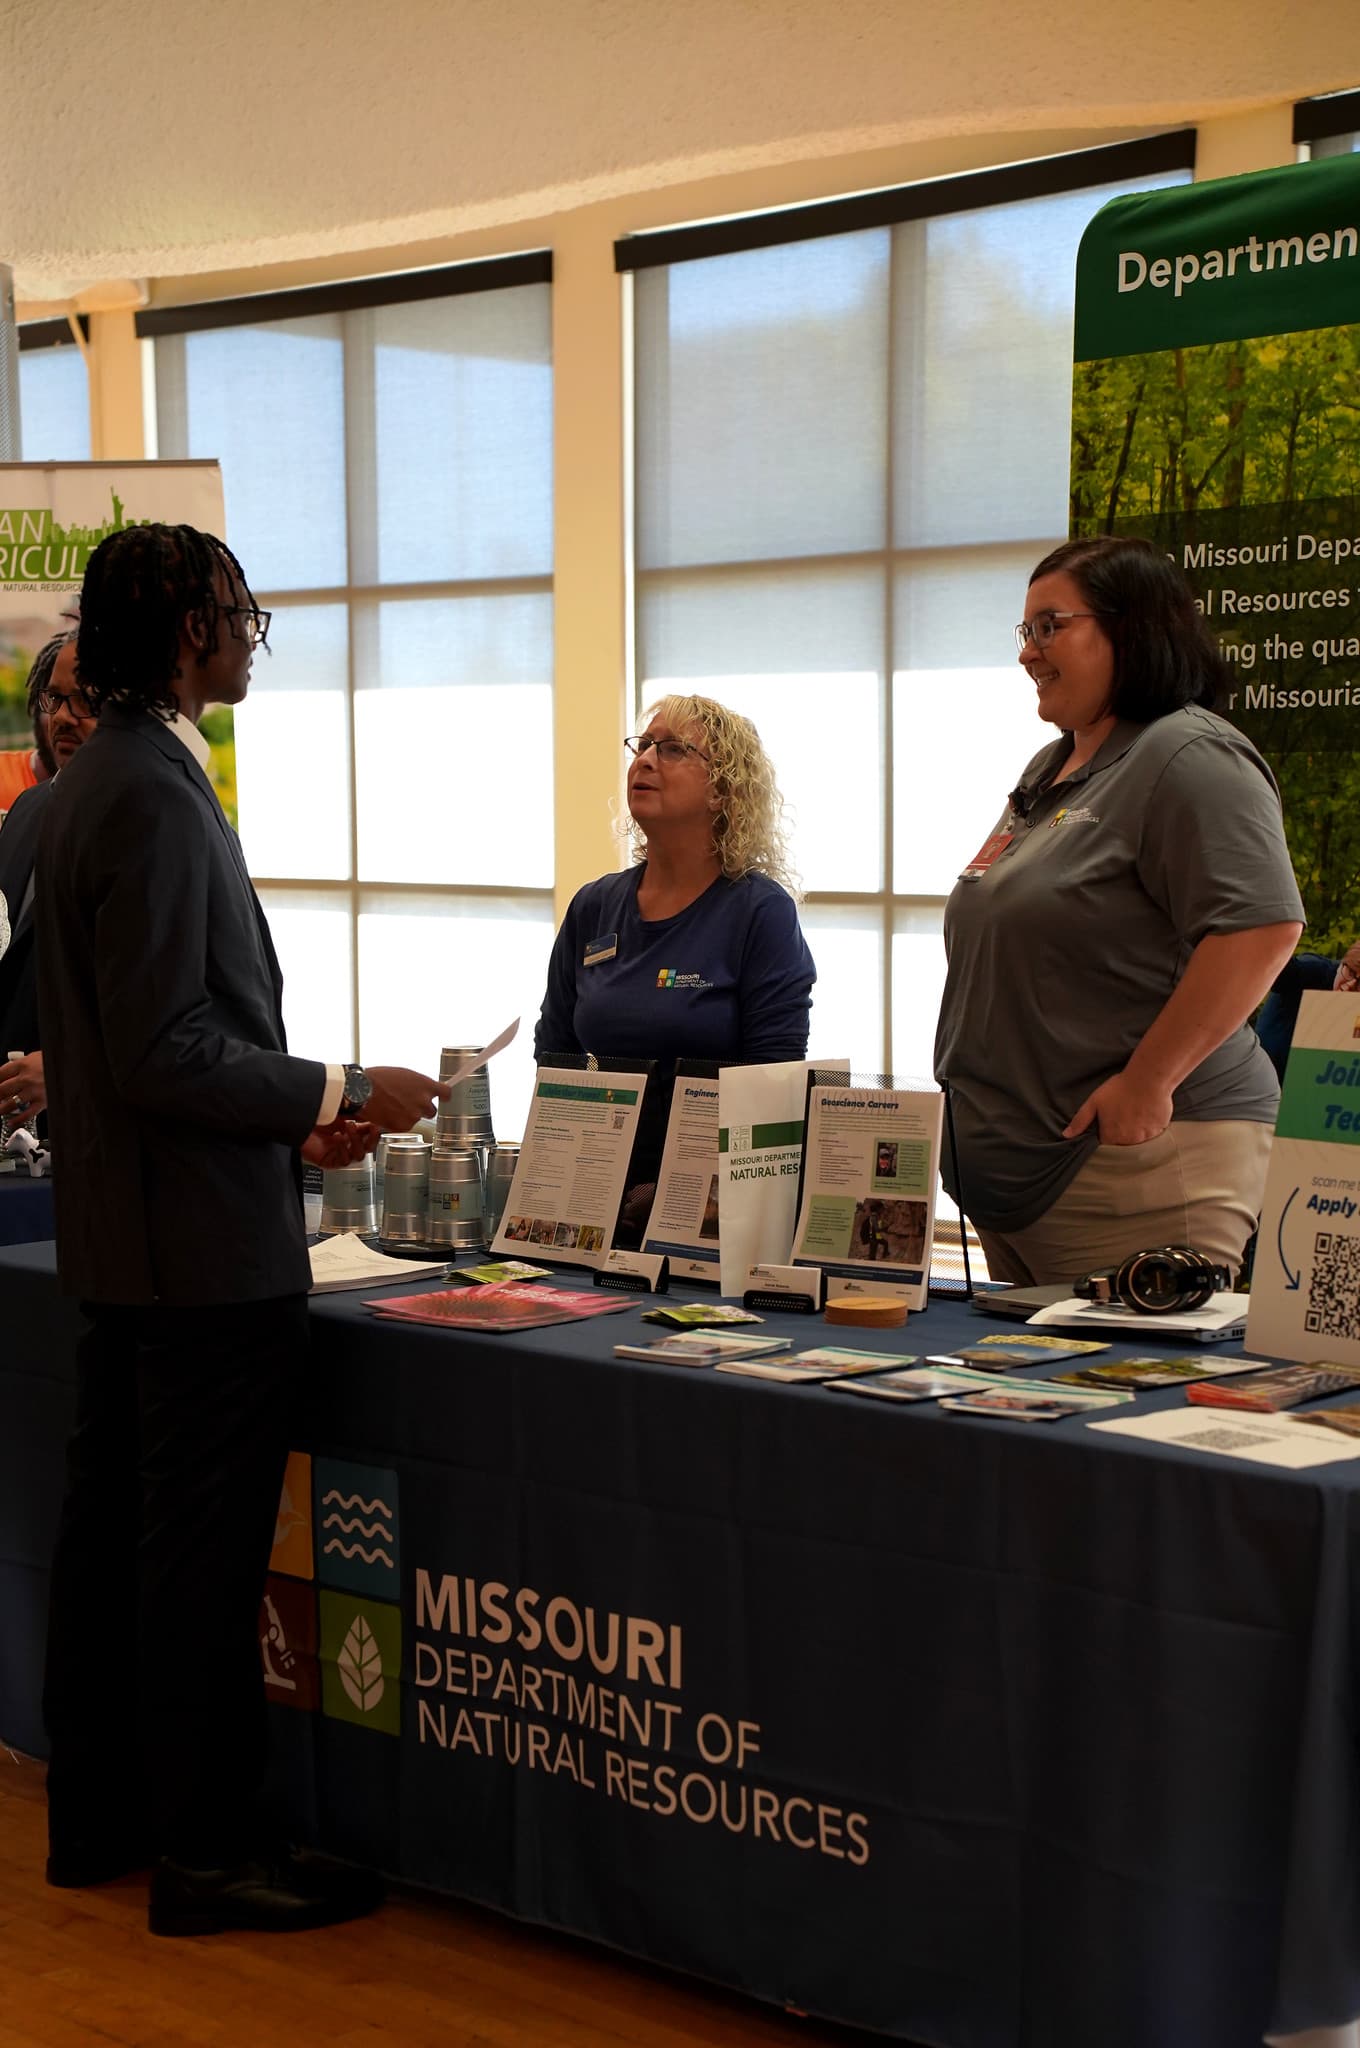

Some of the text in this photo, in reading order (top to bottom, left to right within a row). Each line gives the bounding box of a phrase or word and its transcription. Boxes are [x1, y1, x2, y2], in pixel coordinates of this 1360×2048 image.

[1118, 227, 1358, 297] Departmen
[0, 545, 98, 579] ICUL
[1183, 536, 1288, 569] Missouri
[3, 583, 38, 592] NATURAL
[1221, 588, 1351, 615] Resources
[1264, 633, 1304, 661] the
[1315, 1059, 1360, 1087] Joi
[684, 1088, 719, 1098] Engineer
[821, 1098, 899, 1109] Geoscience Careers
[730, 1151, 801, 1166] MISSOURI DEPARTME
[730, 1163, 801, 1181] NATURAL RES
[1311, 1175, 1337, 1188] scan
[1338, 1178, 1355, 1190] me
[1306, 1194, 1357, 1219] Apply
[415, 1567, 682, 1690] MISSOURI
[415, 1641, 761, 1769] DEPARTMENT OF
[418, 1699, 870, 1866] NATURAL RESOURCES
